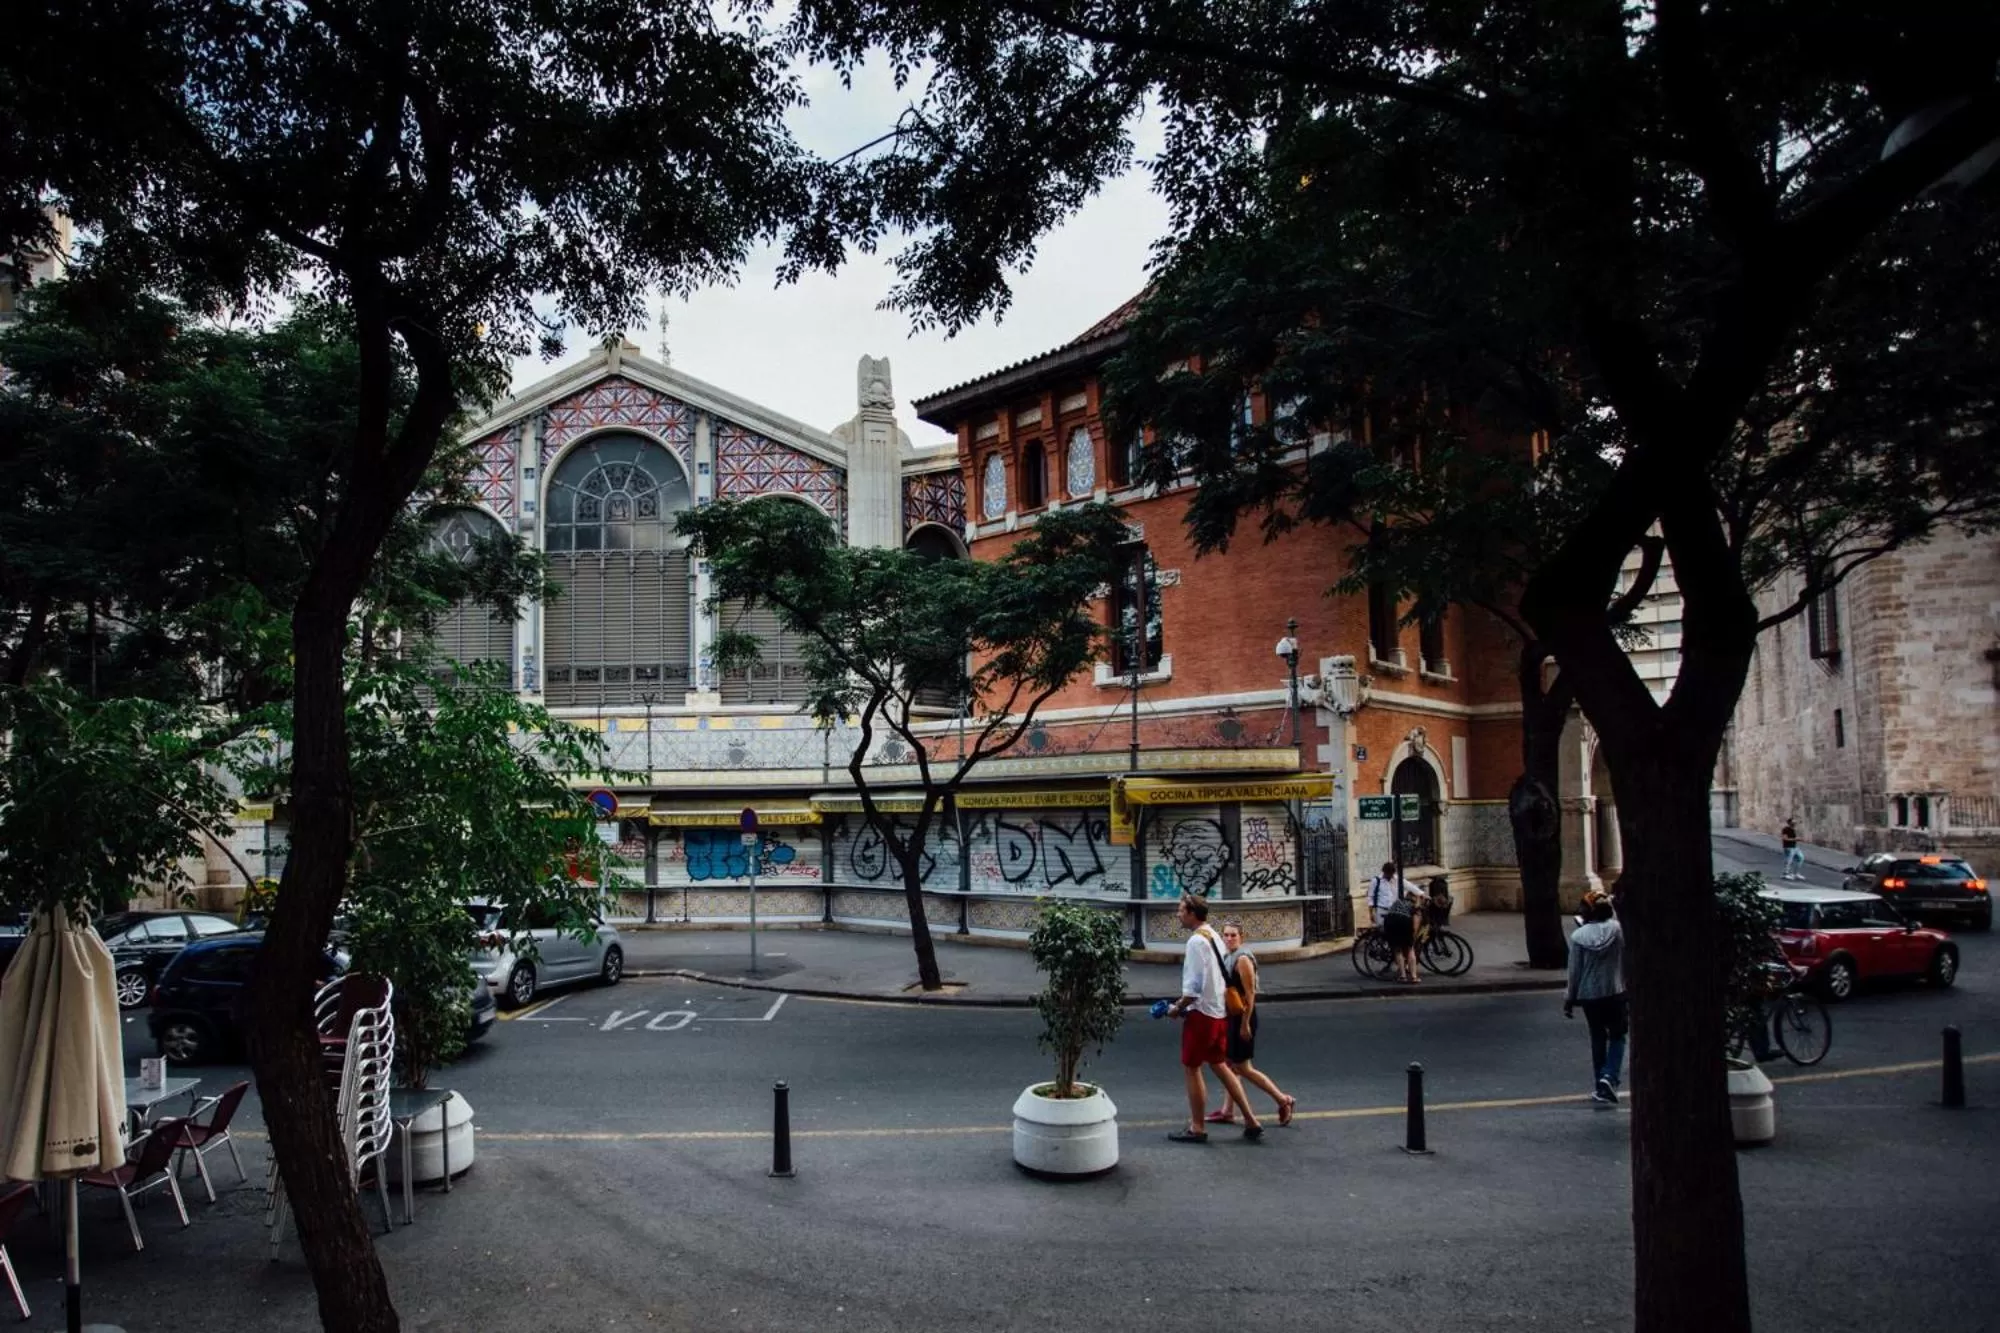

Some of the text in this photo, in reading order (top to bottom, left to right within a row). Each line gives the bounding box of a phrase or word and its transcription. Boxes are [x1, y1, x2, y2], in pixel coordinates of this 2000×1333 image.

[1150, 789, 1193, 801] COCINA
[1236, 785, 1308, 798] VALENCIANA
[1001, 795, 1023, 805] PARA
